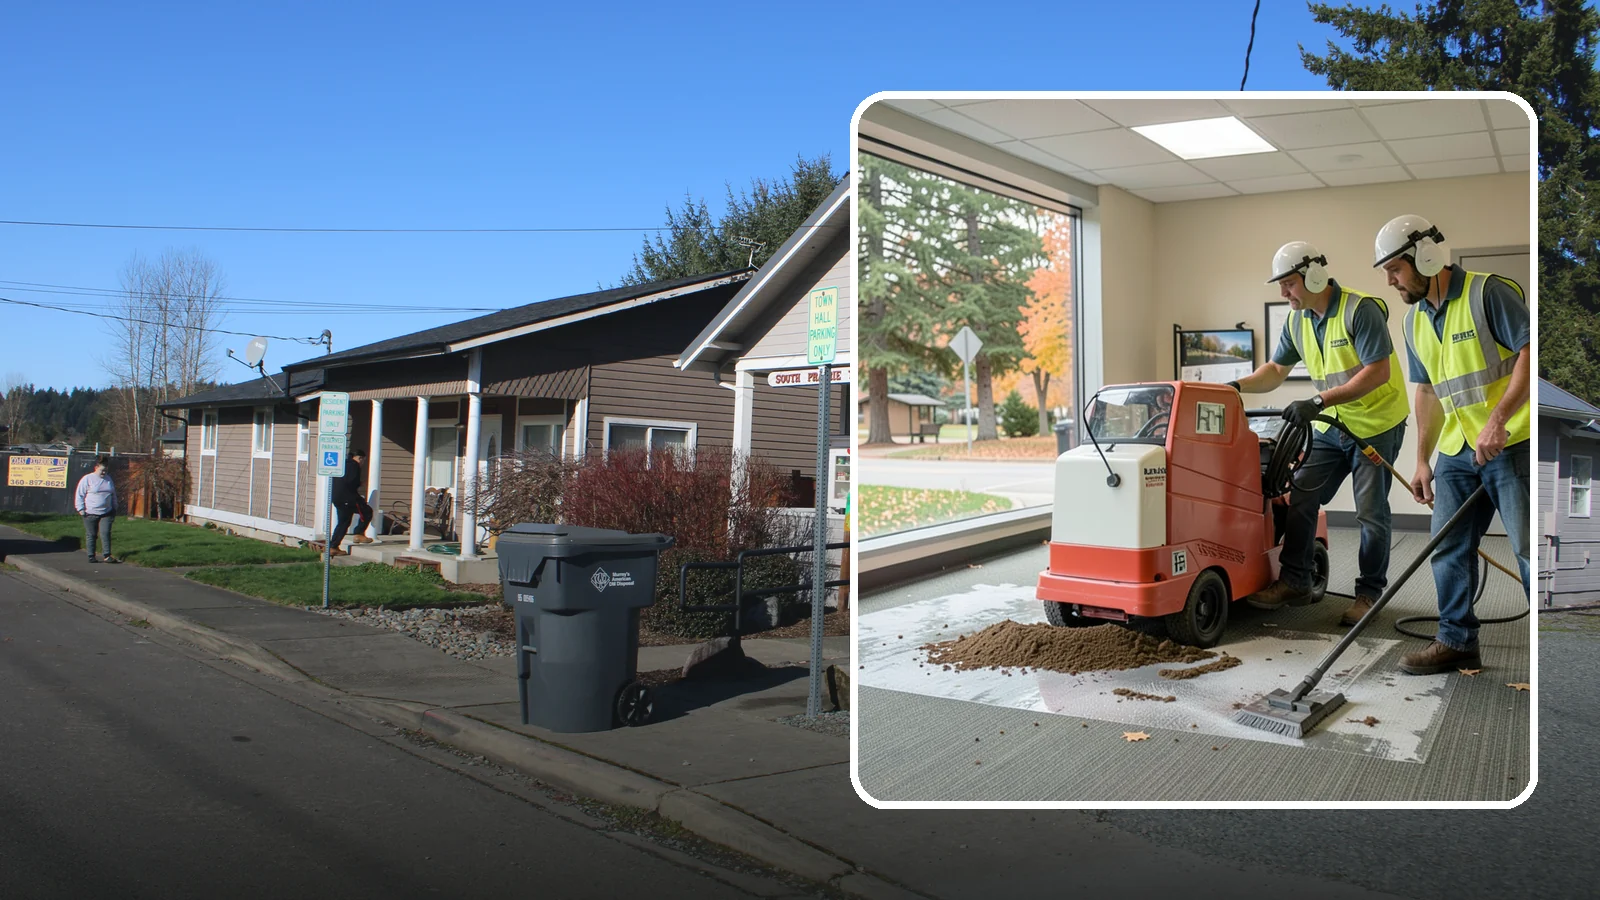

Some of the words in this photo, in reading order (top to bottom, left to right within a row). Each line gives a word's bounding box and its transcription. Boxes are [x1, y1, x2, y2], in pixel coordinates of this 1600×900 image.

[815, 295, 833, 308] TOWN
[814, 311, 831, 324] HALL
[810, 326, 835, 340] PARKING
[813, 344, 831, 357] ONLY
[775, 373, 801, 384] SOUTH
